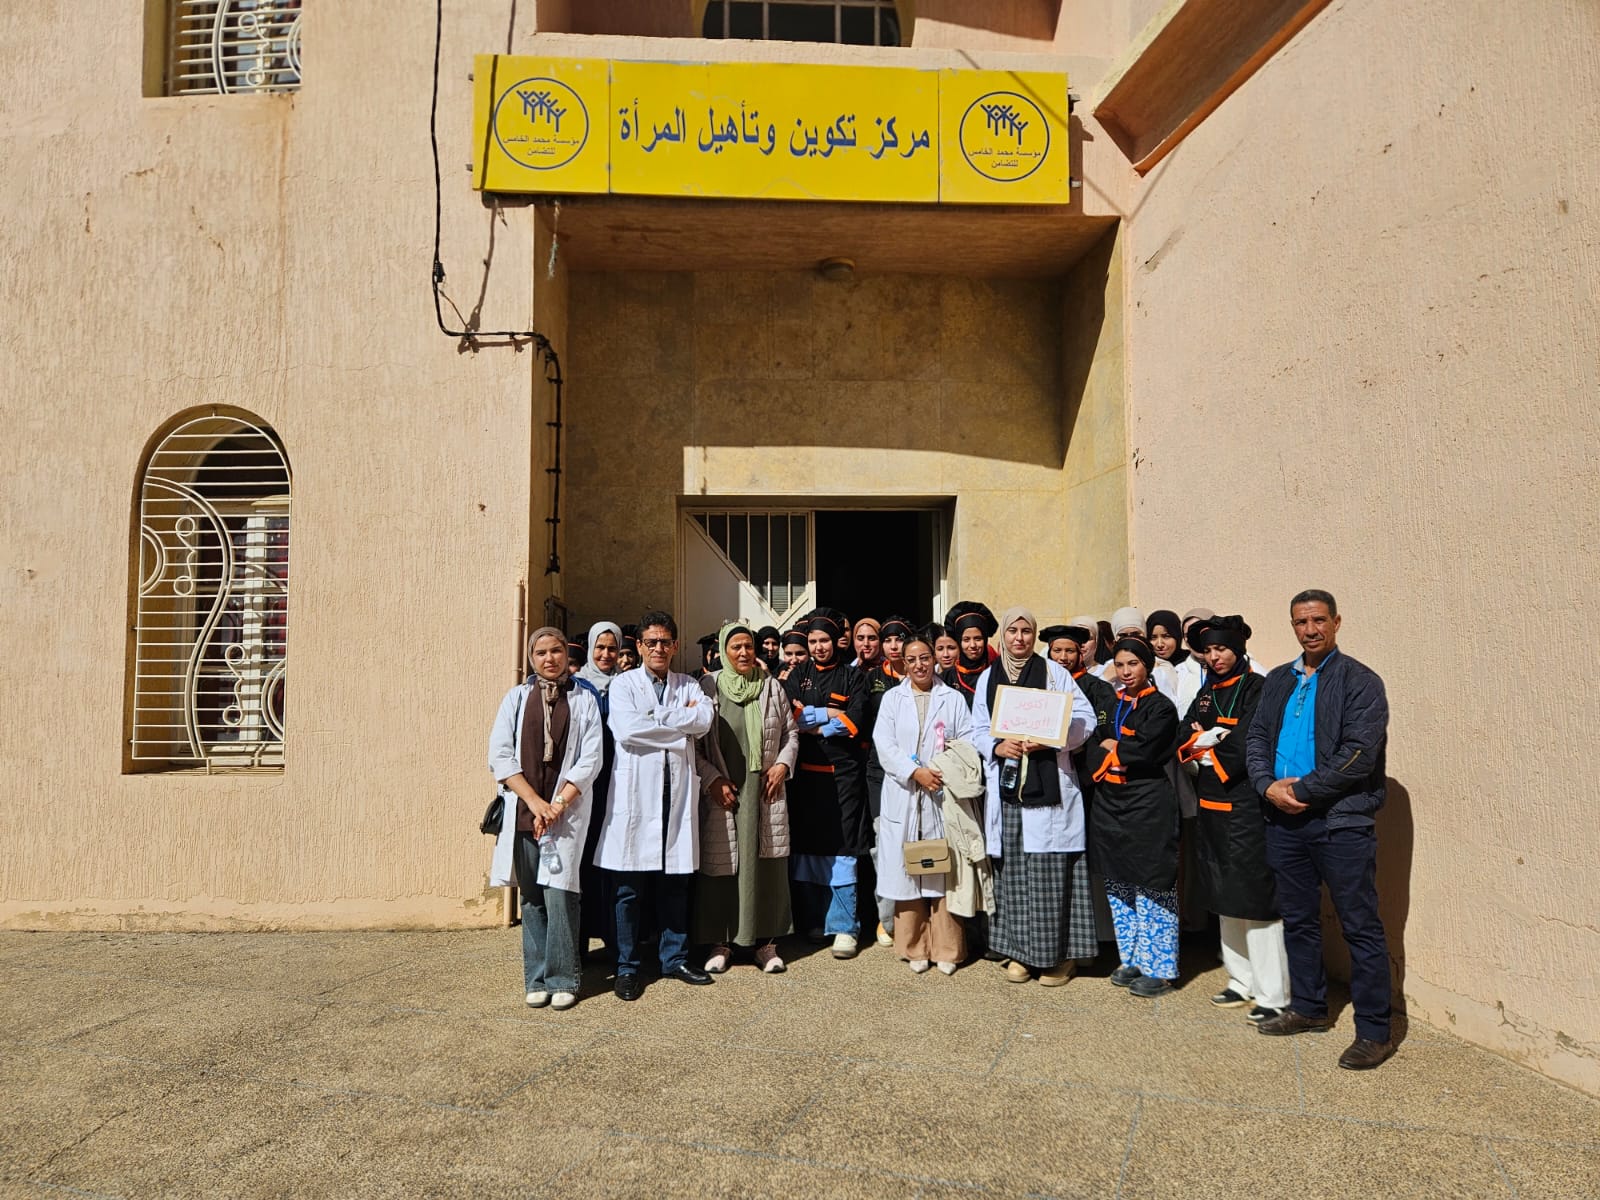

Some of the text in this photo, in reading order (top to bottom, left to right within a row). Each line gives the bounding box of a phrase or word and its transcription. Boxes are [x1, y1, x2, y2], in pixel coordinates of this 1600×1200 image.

[618, 97, 930, 160] مركز تكوين وتأهيل المرأة
